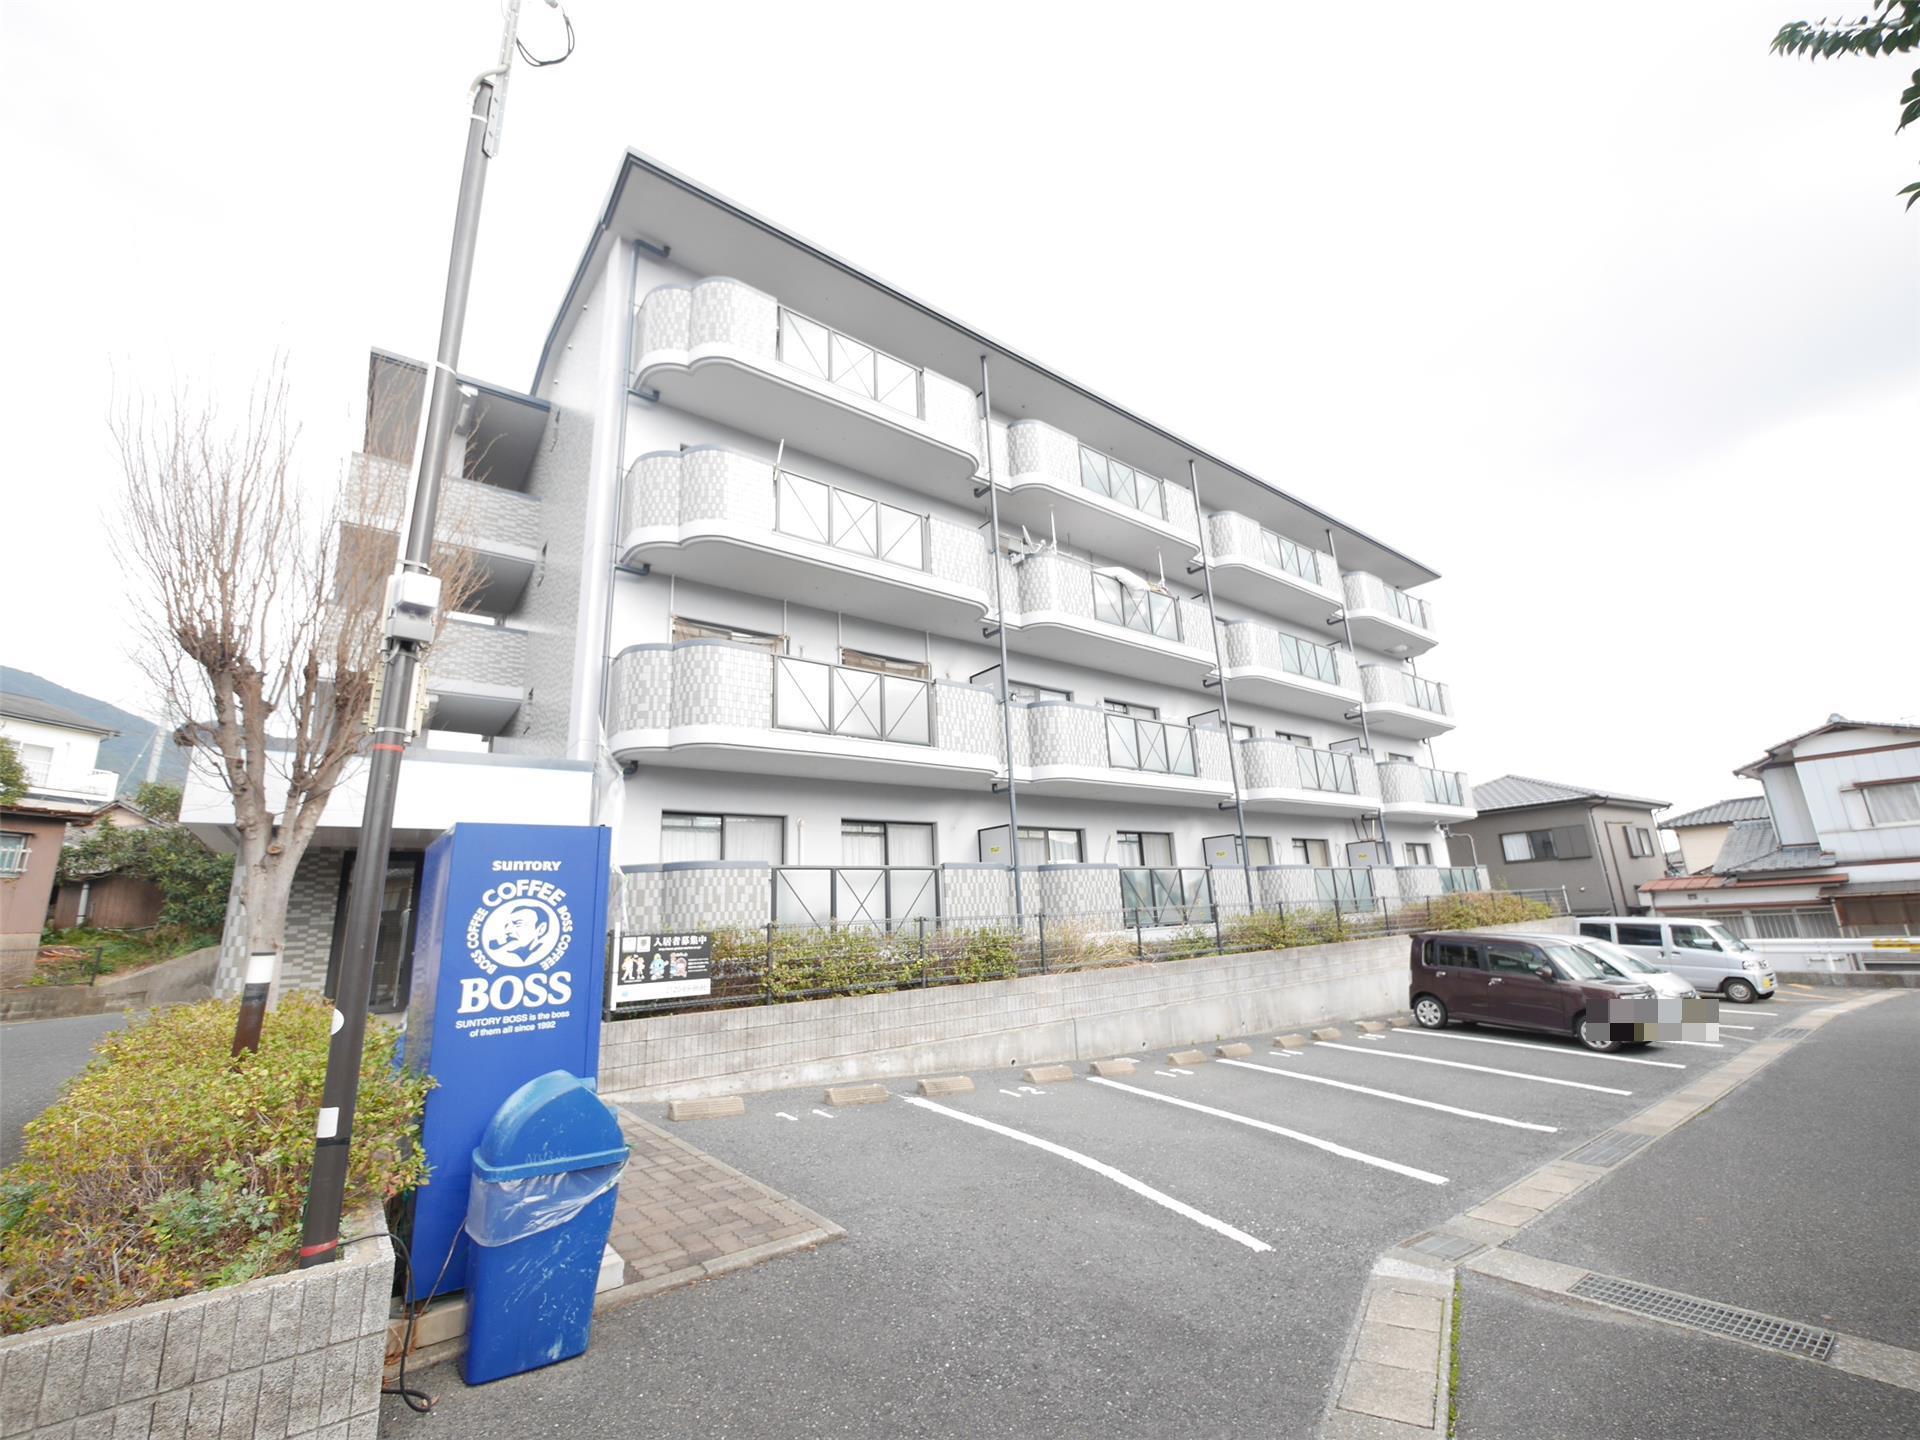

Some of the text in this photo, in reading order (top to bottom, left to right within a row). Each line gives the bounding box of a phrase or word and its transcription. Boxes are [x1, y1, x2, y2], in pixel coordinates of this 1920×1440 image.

[492, 860, 562, 872] SUNTORY
[482, 879, 567, 907] COFFEE
[466, 907, 498, 975] BOSS COFFEE
[539, 905, 573, 971] BOSS COFFEE
[653, 935, 707, 947] 入居者募集中
[457, 971, 572, 1014] BOSS
[456, 1011, 570, 1029] SUNTORY BOSS is the boss
[469, 1020, 556, 1038] of them all since 1992
[999, 1086, 1046, 1098] 12
